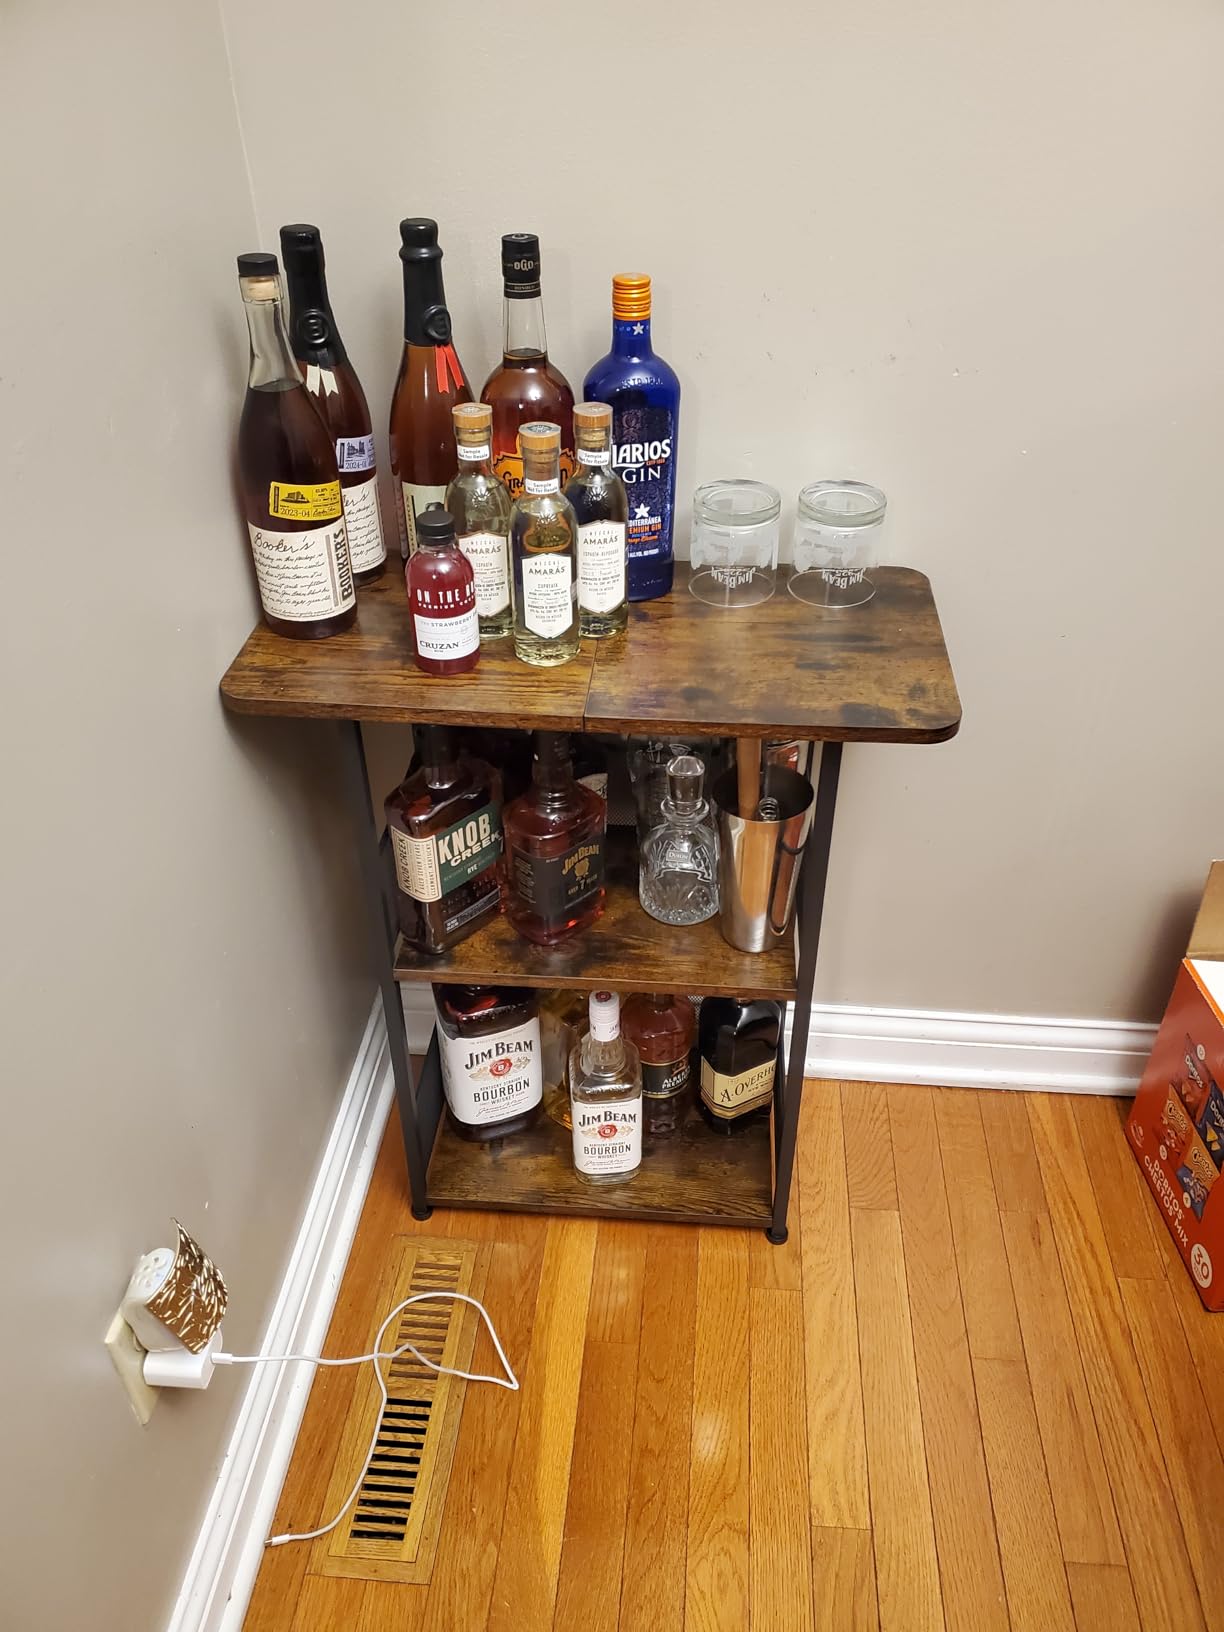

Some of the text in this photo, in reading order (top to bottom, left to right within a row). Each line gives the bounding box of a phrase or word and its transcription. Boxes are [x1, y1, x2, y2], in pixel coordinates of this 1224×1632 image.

[612, 438, 671, 467] LARIOS
[622, 467, 661, 484] GIN
[281, 508, 310, 518] 2023-04
[583, 535, 619, 545] AMARÁS
[629, 525, 650, 534] EMIUM
[254, 532, 315, 553] Booker's
[465, 544, 502, 555] AMARÁS
[334, 528, 353, 601] BOOKER'S
[528, 565, 566, 575] AMARÁS
[416, 588, 431, 603] ON
[438, 588, 460, 603] THE
[420, 640, 459, 650] CRUZAN
[438, 813, 491, 865] KNOB
[450, 830, 500, 867] CREEK
[399, 838, 412, 891] KNOB CREEK
[467, 863, 478, 875] RYE
[562, 844, 600, 875] JIM BEAM
[465, 1039, 535, 1071] JIM BEAM
[1185, 1054, 1204, 1089] Doritos
[473, 1078, 530, 1103] BOURBON
[579, 1110, 638, 1128] JIM BEAM
[583, 1144, 632, 1156] BOURBON
[1154, 1159, 1183, 1219] DORITOS
[1144, 1155, 1189, 1247] CHEETOS MIX
[1193, 1246, 1210, 1280] 30
